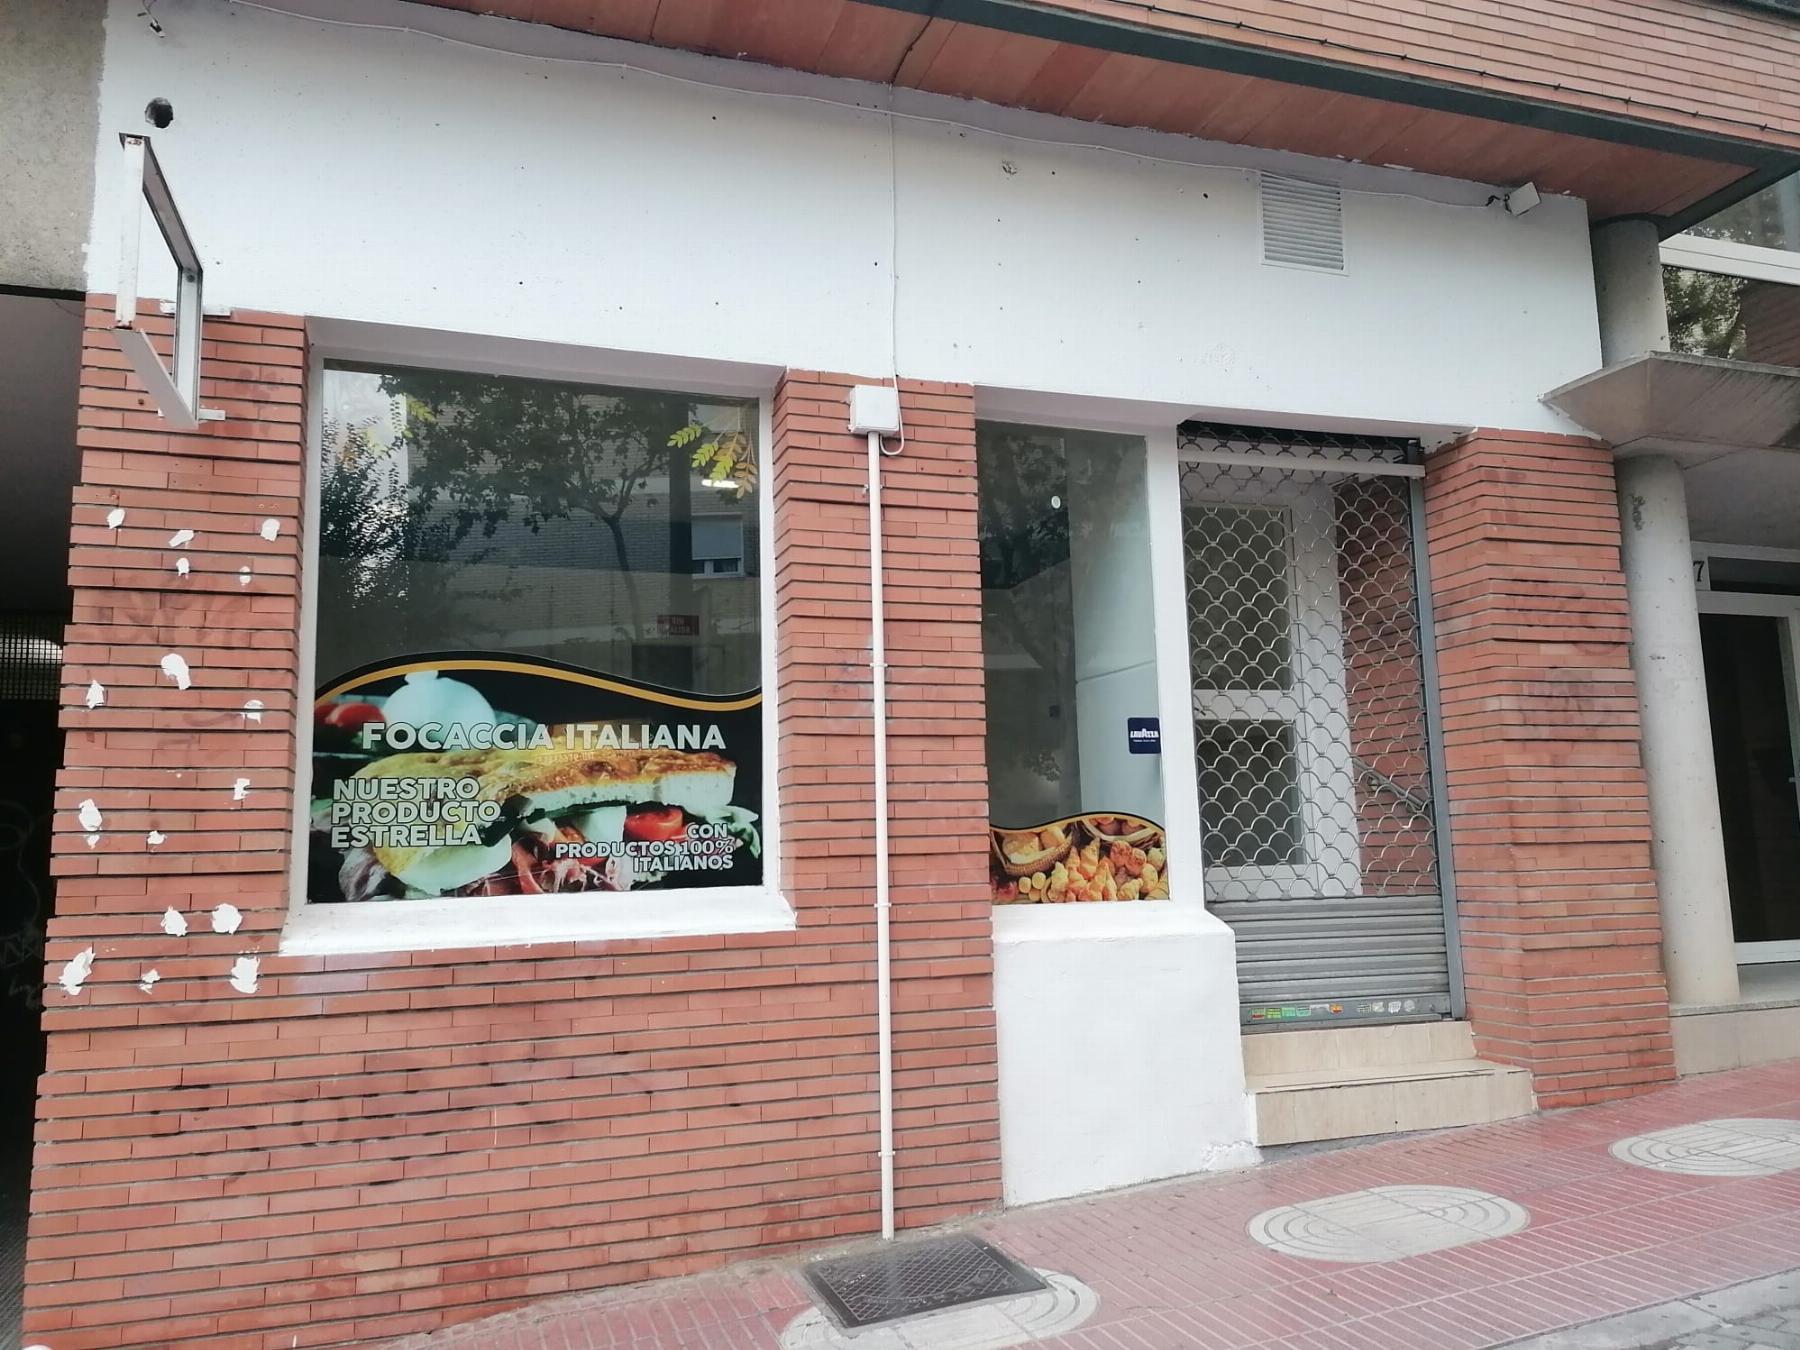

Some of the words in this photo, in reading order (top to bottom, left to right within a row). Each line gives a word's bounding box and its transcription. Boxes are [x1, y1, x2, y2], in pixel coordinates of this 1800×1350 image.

[1693, 560, 1705, 582] 7
[362, 721, 555, 750] FOCACCIA
[565, 723, 726, 750] ITALIANA
[333, 777, 479, 800] NUESTRO
[331, 800, 501, 824] PRODUCTO
[331, 823, 482, 848] ESTRELLA
[688, 823, 728, 838] CON
[555, 841, 676, 858] PRODUCTOS
[681, 839, 734, 855] 100%
[633, 855, 734, 871] ITALIANOS
